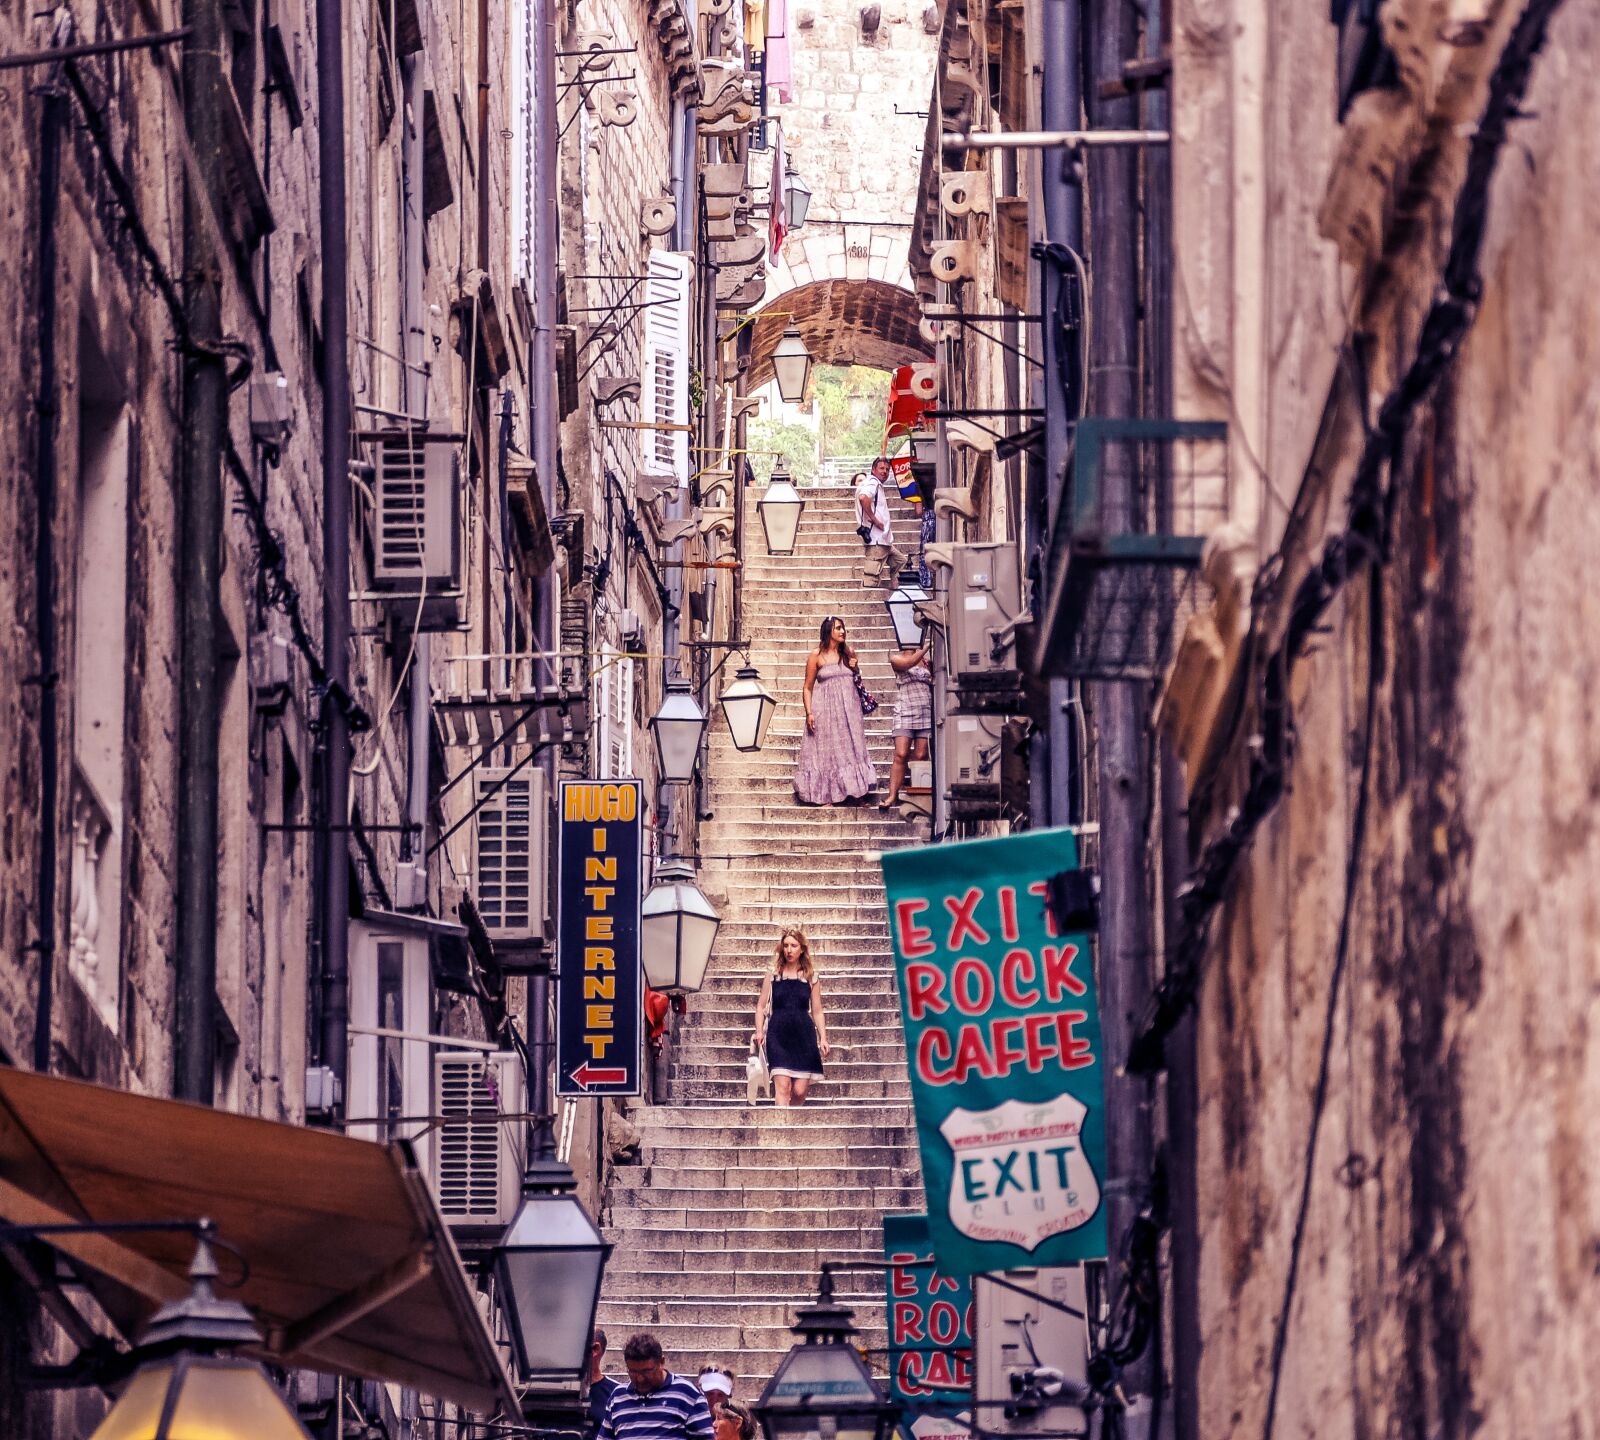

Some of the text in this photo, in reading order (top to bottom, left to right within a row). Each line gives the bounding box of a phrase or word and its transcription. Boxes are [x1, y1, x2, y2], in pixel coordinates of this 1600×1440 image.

[564, 784, 637, 822] HUGO
[584, 828, 617, 1059] INTERNET
[905, 944, 1088, 1021] ROCK
[915, 1010, 1096, 1087] CAFFE
[960, 1146, 1076, 1203] EXIT
